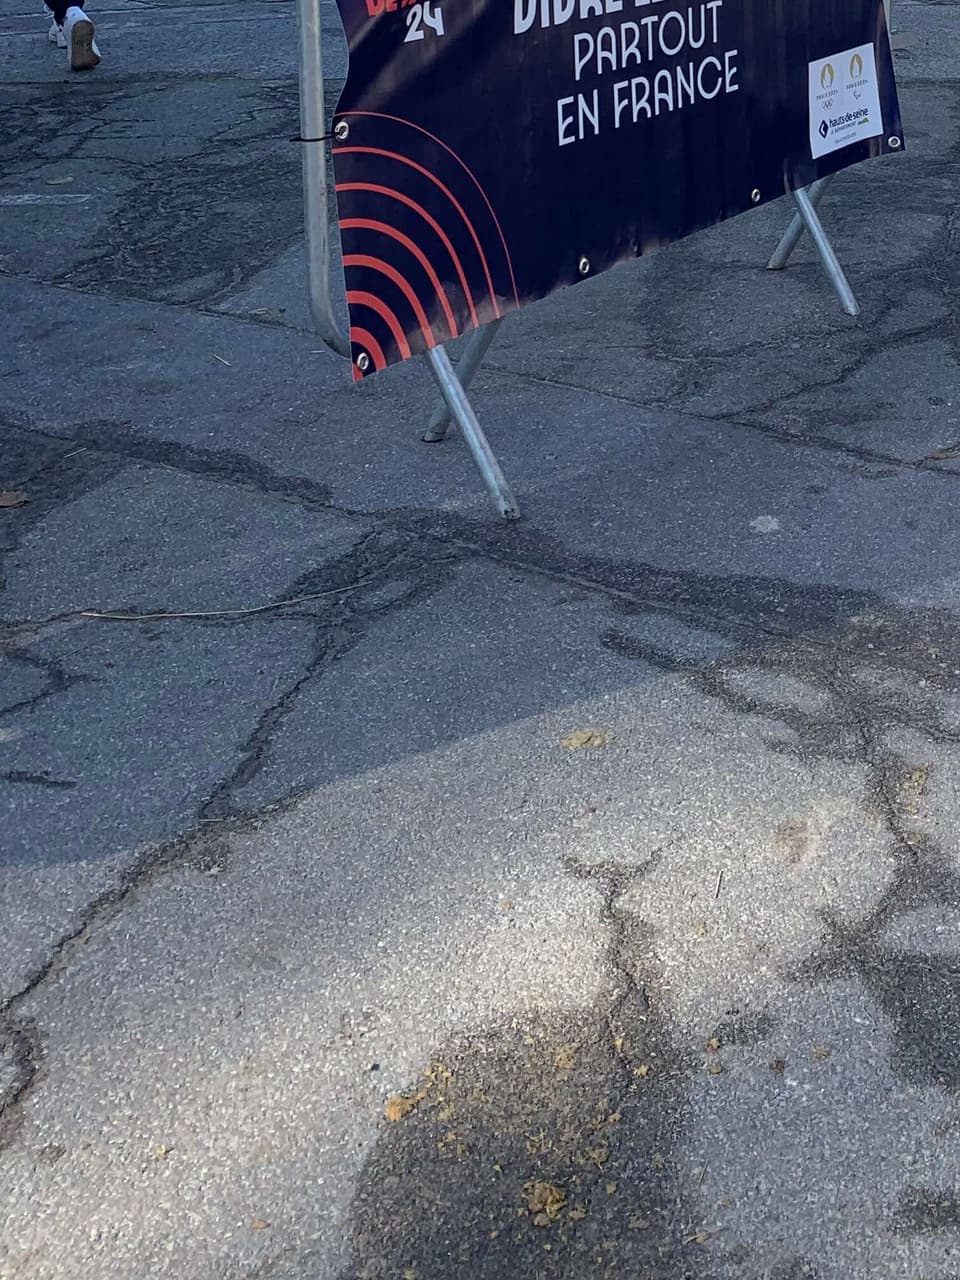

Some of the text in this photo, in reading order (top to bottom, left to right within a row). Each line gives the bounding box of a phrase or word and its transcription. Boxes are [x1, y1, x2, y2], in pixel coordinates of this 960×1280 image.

[404, 1, 444, 42] 24
[574, 0, 723, 80] PARTOUT
[557, 49, 739, 146] EN FRANCE
